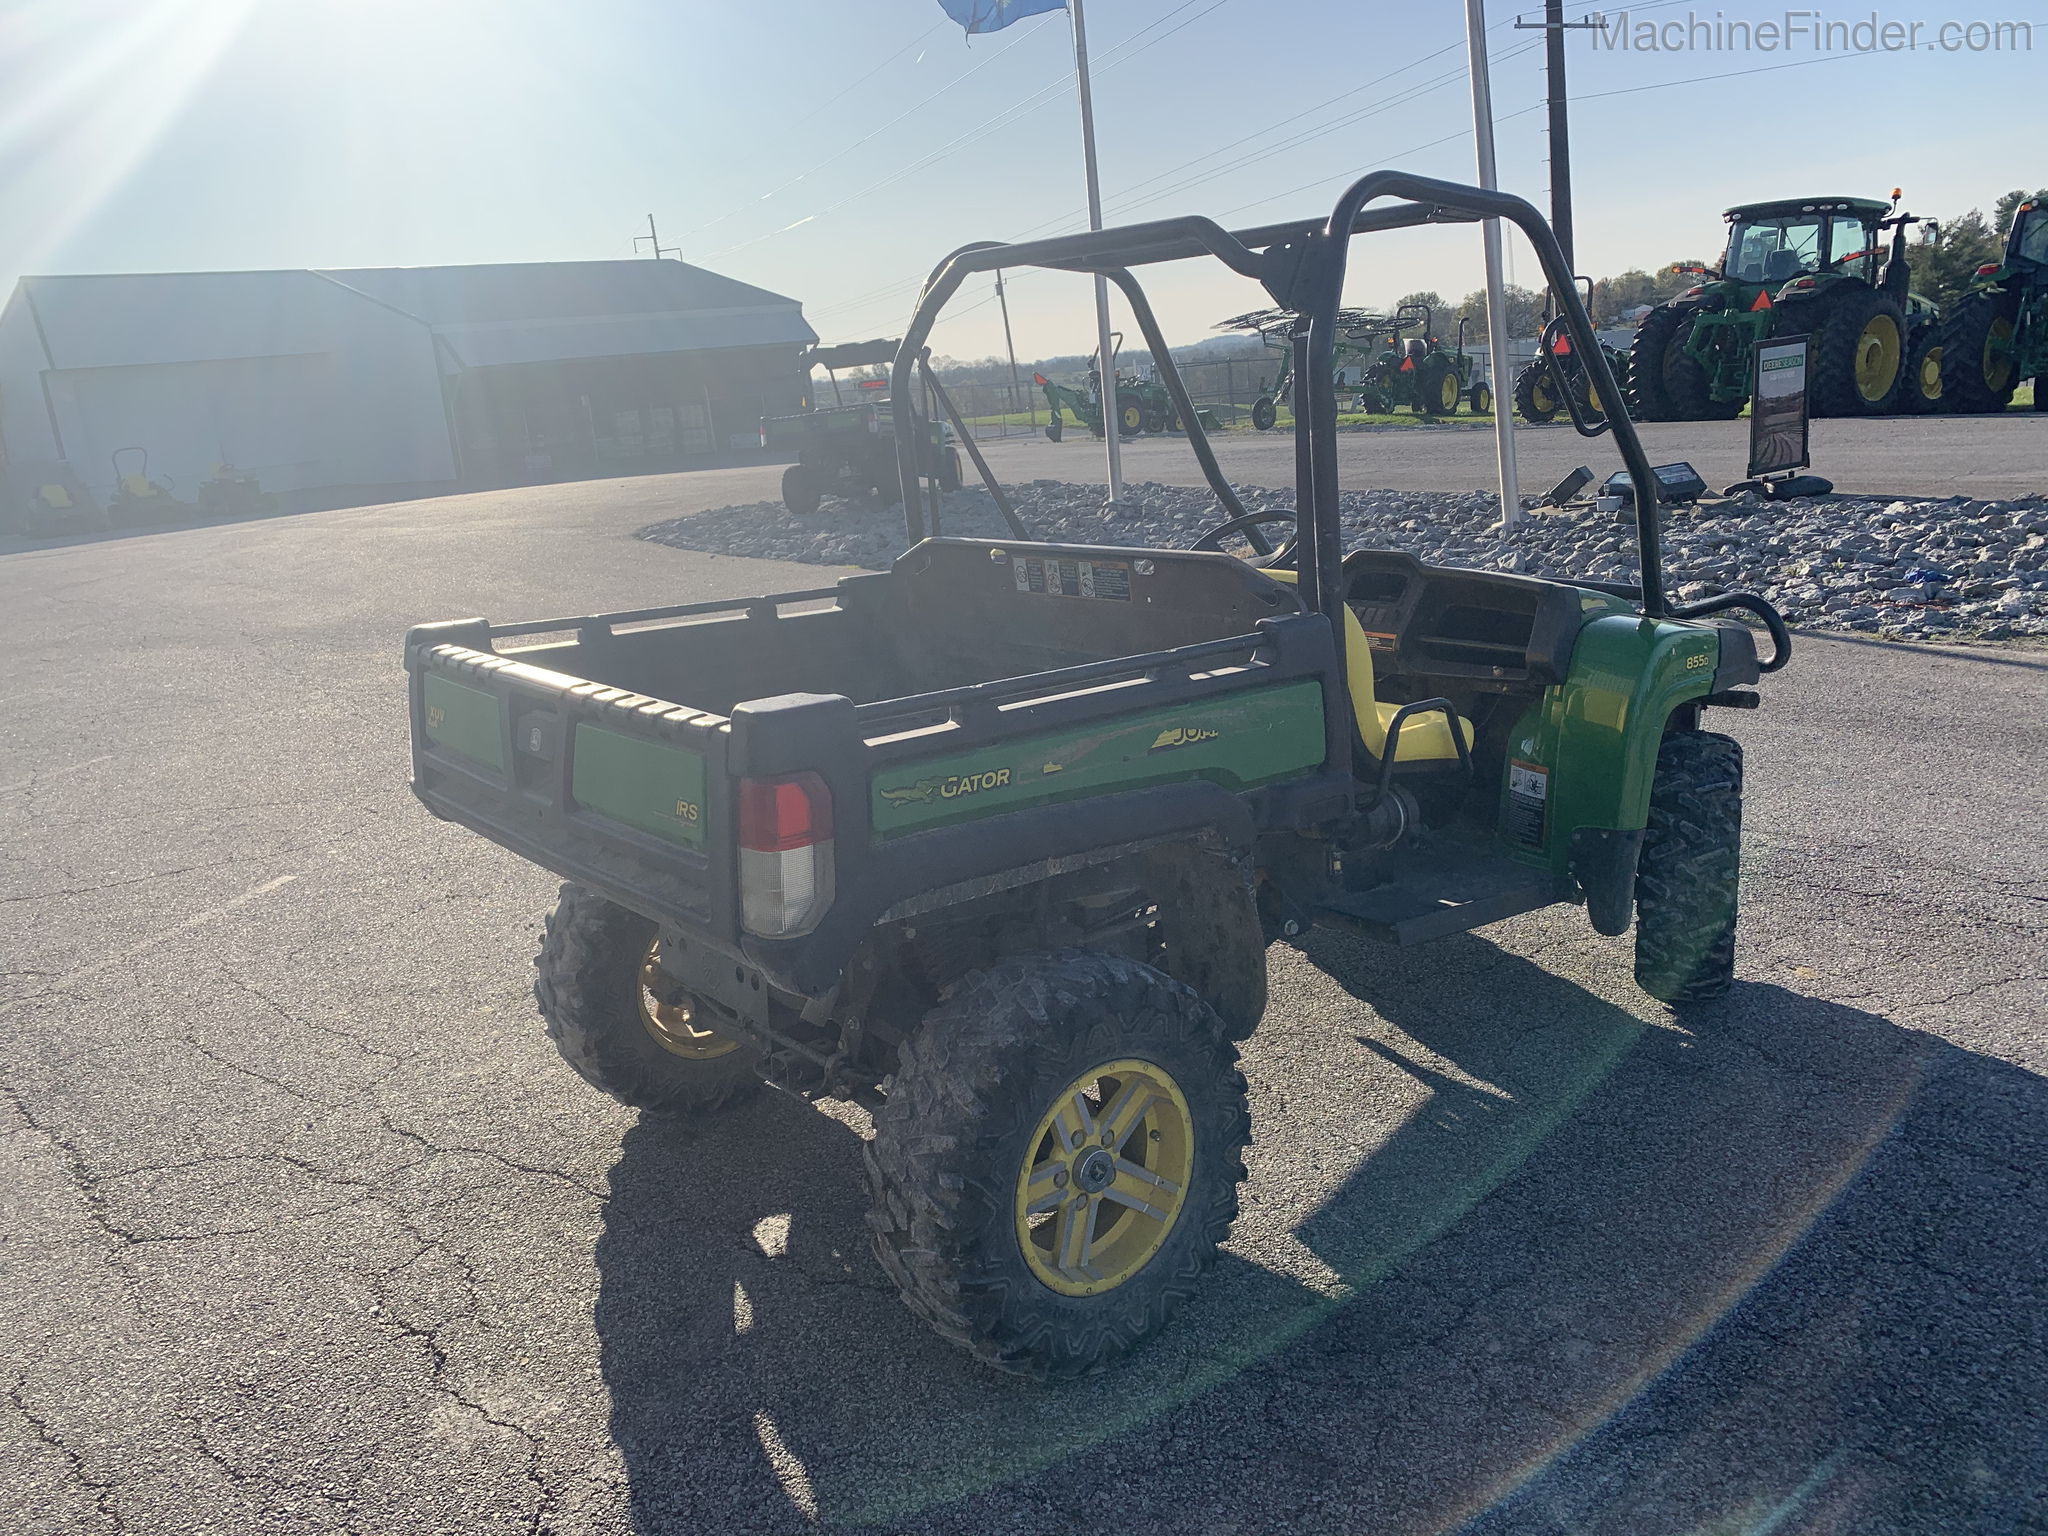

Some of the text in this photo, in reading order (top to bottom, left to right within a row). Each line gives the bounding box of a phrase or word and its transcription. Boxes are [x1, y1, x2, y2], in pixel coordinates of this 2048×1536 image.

[428, 705, 445, 722] XUV
[940, 768, 1011, 799] GATOR
[675, 799, 698, 821] IRS
